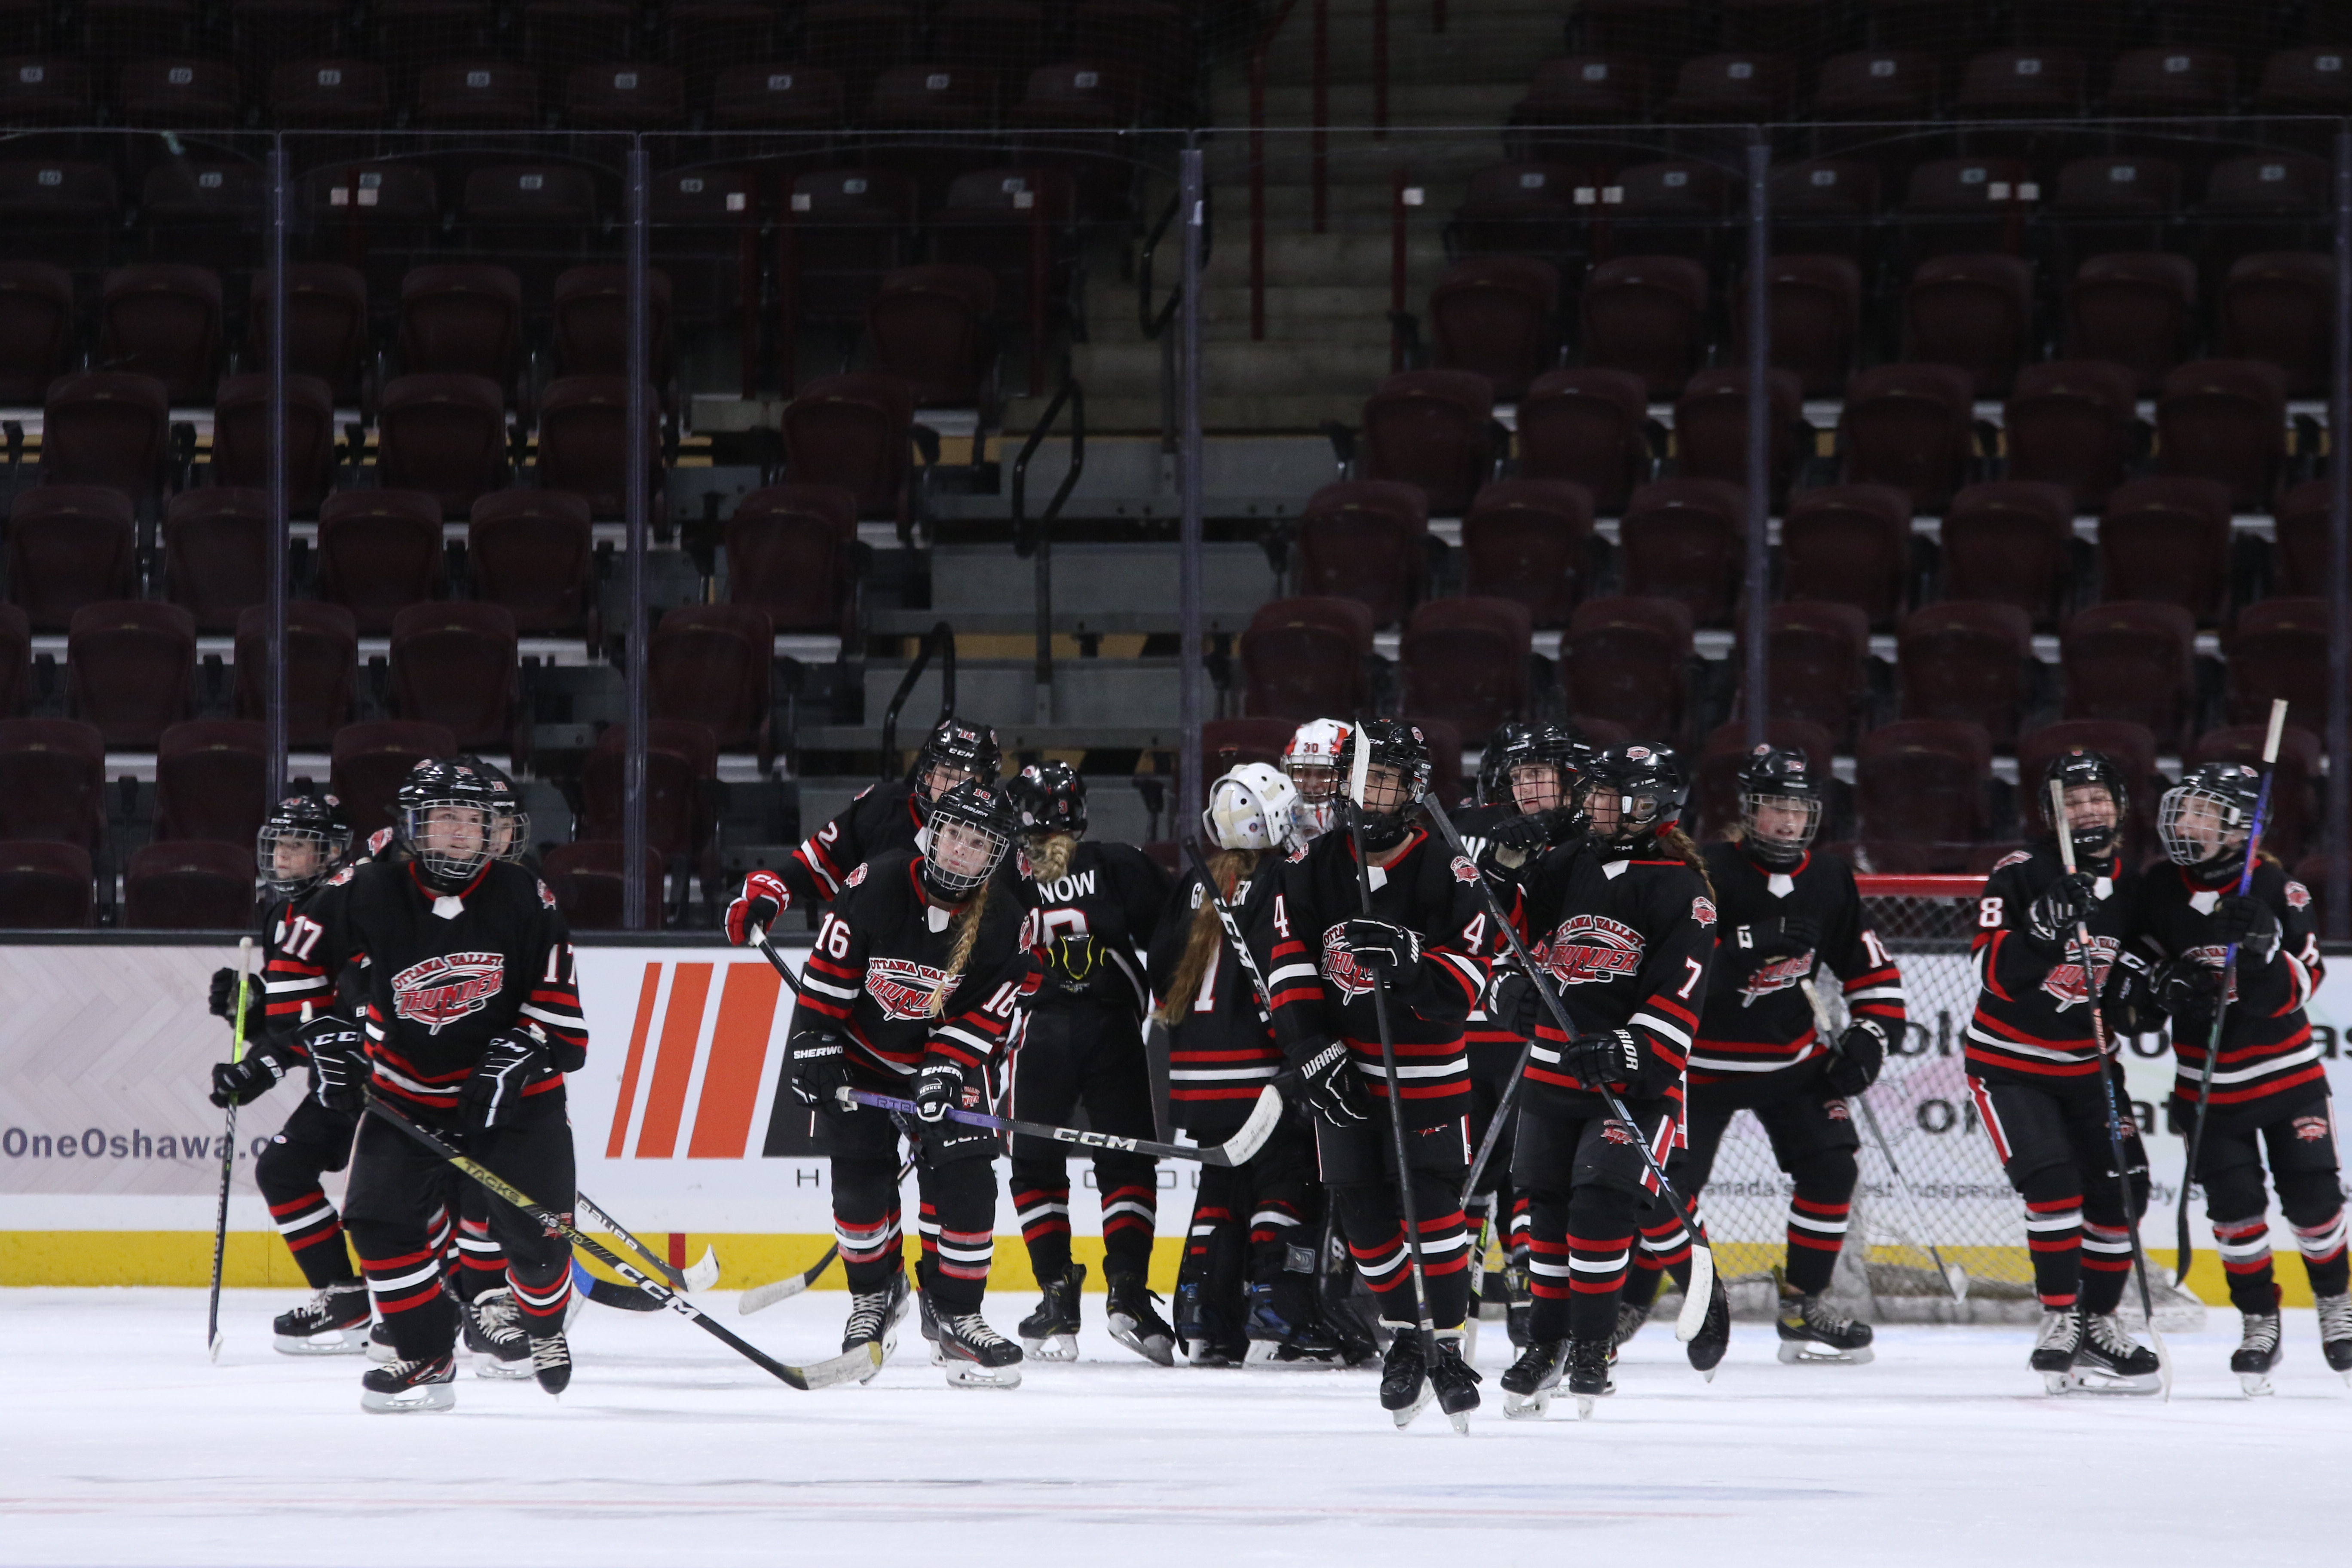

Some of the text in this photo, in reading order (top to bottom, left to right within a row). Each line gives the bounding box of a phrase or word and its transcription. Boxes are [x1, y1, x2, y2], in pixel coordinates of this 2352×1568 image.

[948, 747, 975, 759] CCM
[1304, 742, 1319, 753] 30
[973, 788, 992, 800] 16
[1273, 894, 1290, 939] 4
[1462, 912, 1486, 956] 4
[1593, 918, 1645, 947] VALLEY
[1978, 896, 2004, 928] 8
[281, 914, 324, 962] 17
[815, 912, 851, 960] 16
[392, 953, 504, 991] OTTAWA VALLEY
[395, 969, 504, 1017] THUNDER
[1676, 956, 1703, 1000] 7
[981, 980, 1022, 1019] 16
[1053, 1127, 1137, 1152] CCM
[464, 1160, 524, 1204] TACKS
[578, 1197, 639, 1251] BAUER
[614, 1262, 701, 1321] CCM
